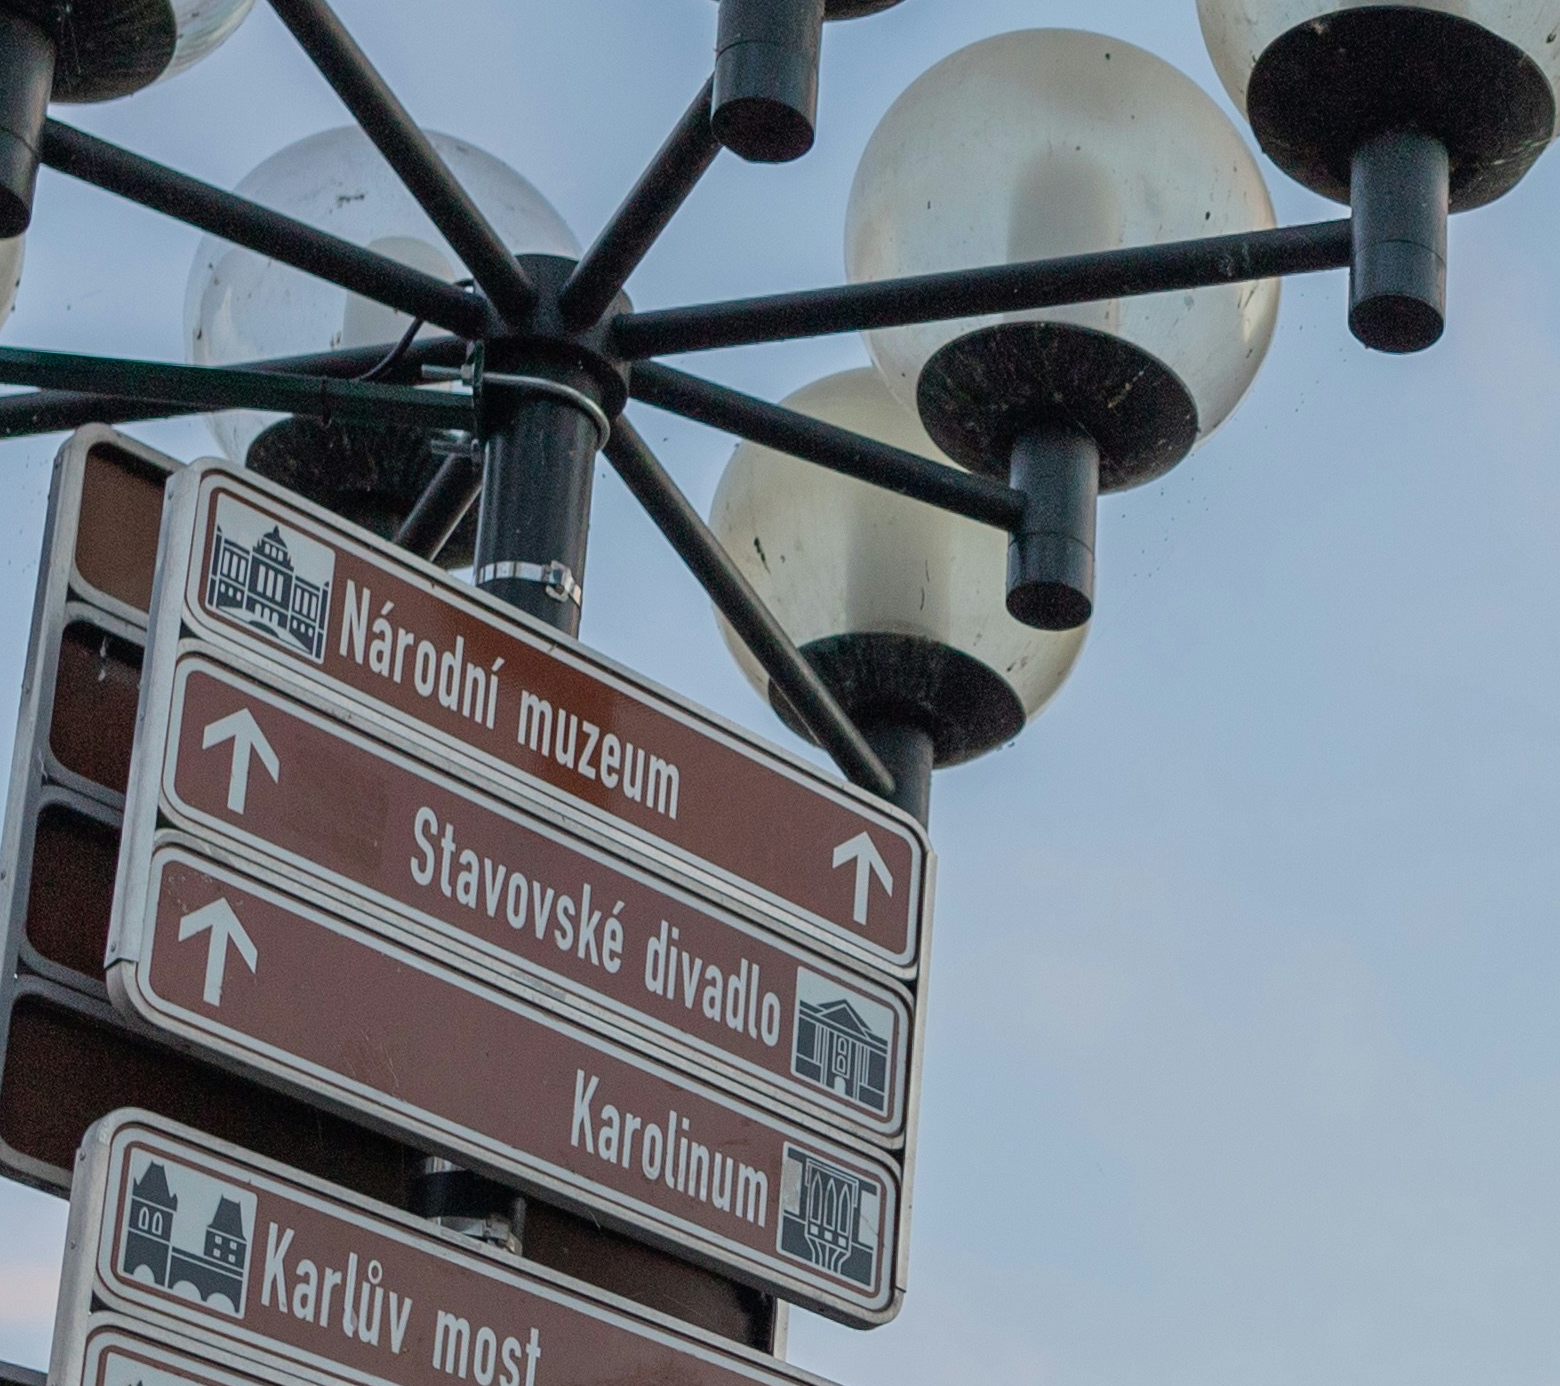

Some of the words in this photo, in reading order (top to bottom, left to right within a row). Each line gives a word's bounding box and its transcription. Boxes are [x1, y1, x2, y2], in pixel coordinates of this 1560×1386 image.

[339, 579, 505, 730] Národní
[517, 690, 680, 820] muzeum
[410, 806, 626, 974] Stavovské
[644, 919, 781, 1047] divadlo
[570, 1068, 769, 1228] Karolinum
[260, 1221, 413, 1354] Karlův
